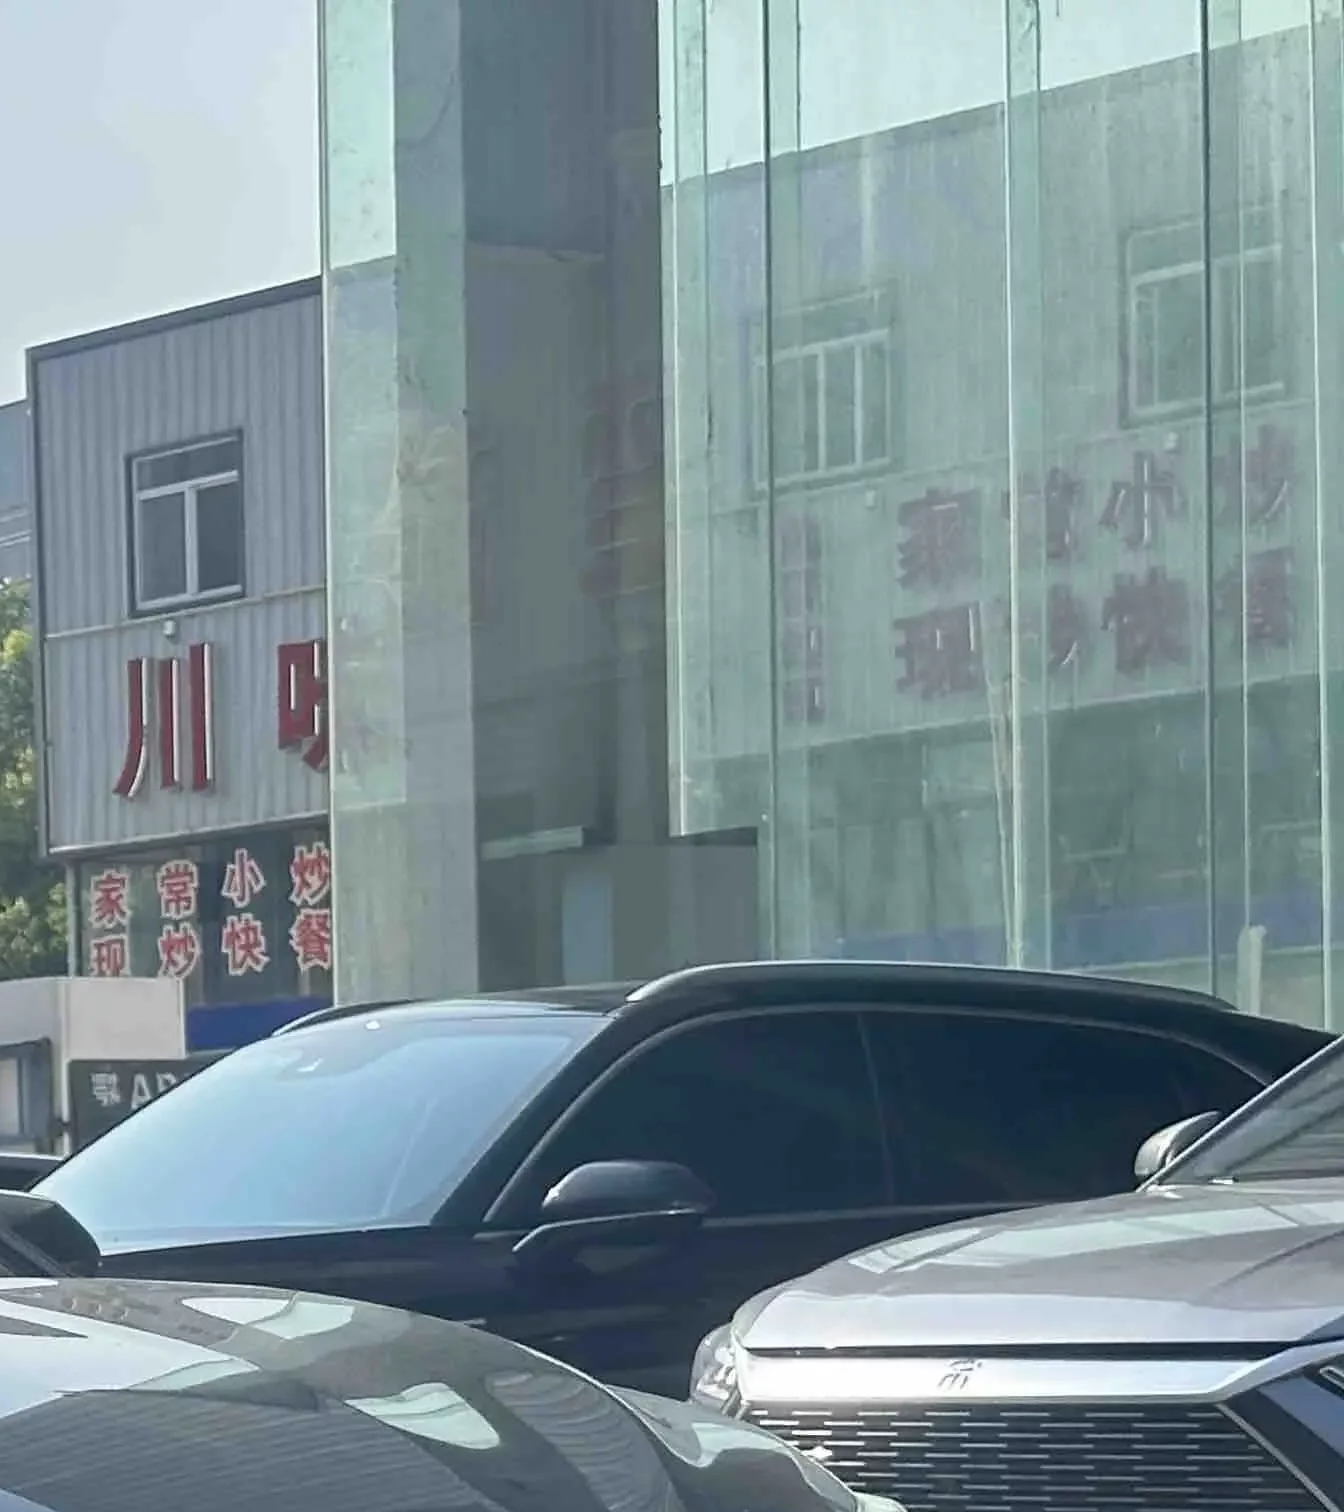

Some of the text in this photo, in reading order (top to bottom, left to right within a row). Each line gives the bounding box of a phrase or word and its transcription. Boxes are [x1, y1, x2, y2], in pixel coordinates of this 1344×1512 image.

[89, 842, 330, 929] 家常小炒
[89, 908, 330, 980] 现炒快餐
